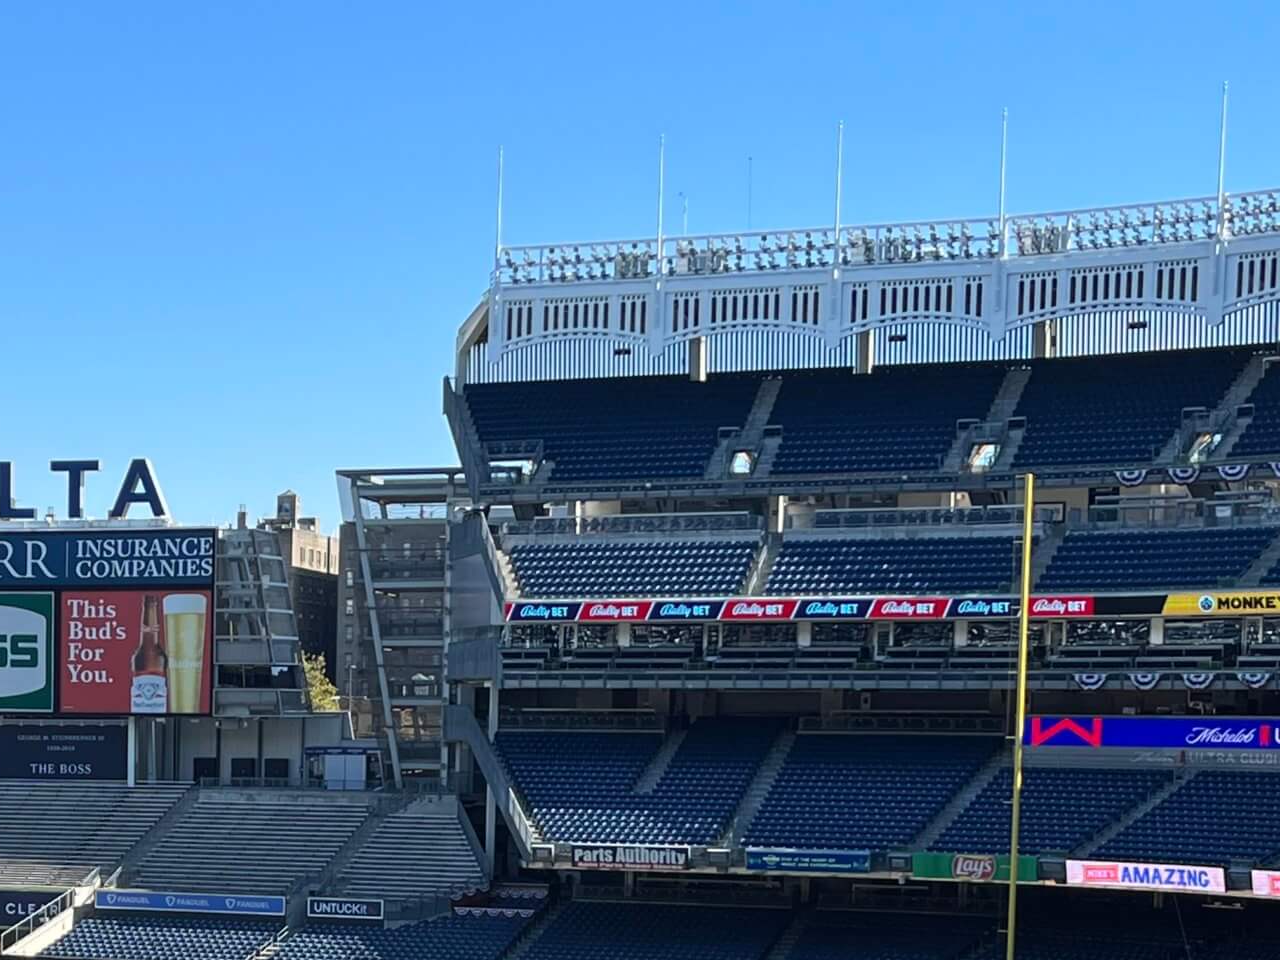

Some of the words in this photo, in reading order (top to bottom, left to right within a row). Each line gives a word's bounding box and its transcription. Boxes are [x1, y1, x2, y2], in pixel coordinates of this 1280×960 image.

[76, 537, 213, 557] INSURANCE
[75, 558, 213, 578] COMPANIES
[67, 600, 116, 618] This
[551, 606, 568, 617] BET
[622, 605, 638, 617] BET
[692, 604, 710, 616] BET
[766, 604, 783, 615] BET
[840, 603, 858, 614] BET
[915, 603, 934, 614] BET
[991, 602, 1010, 613] BET
[1067, 600, 1086, 612] BET
[68, 622, 127, 639] Bud's
[67, 643, 104, 661] For
[67, 664, 113, 683] You.
[30, 764, 55, 774] THE
[60, 764, 92, 774] BOSS
[574, 848, 613, 862] Parts
[616, 848, 685, 865] Authority
[1121, 867, 1210, 887] AMAZING
[314, 902, 367, 914] UNTUCKit
